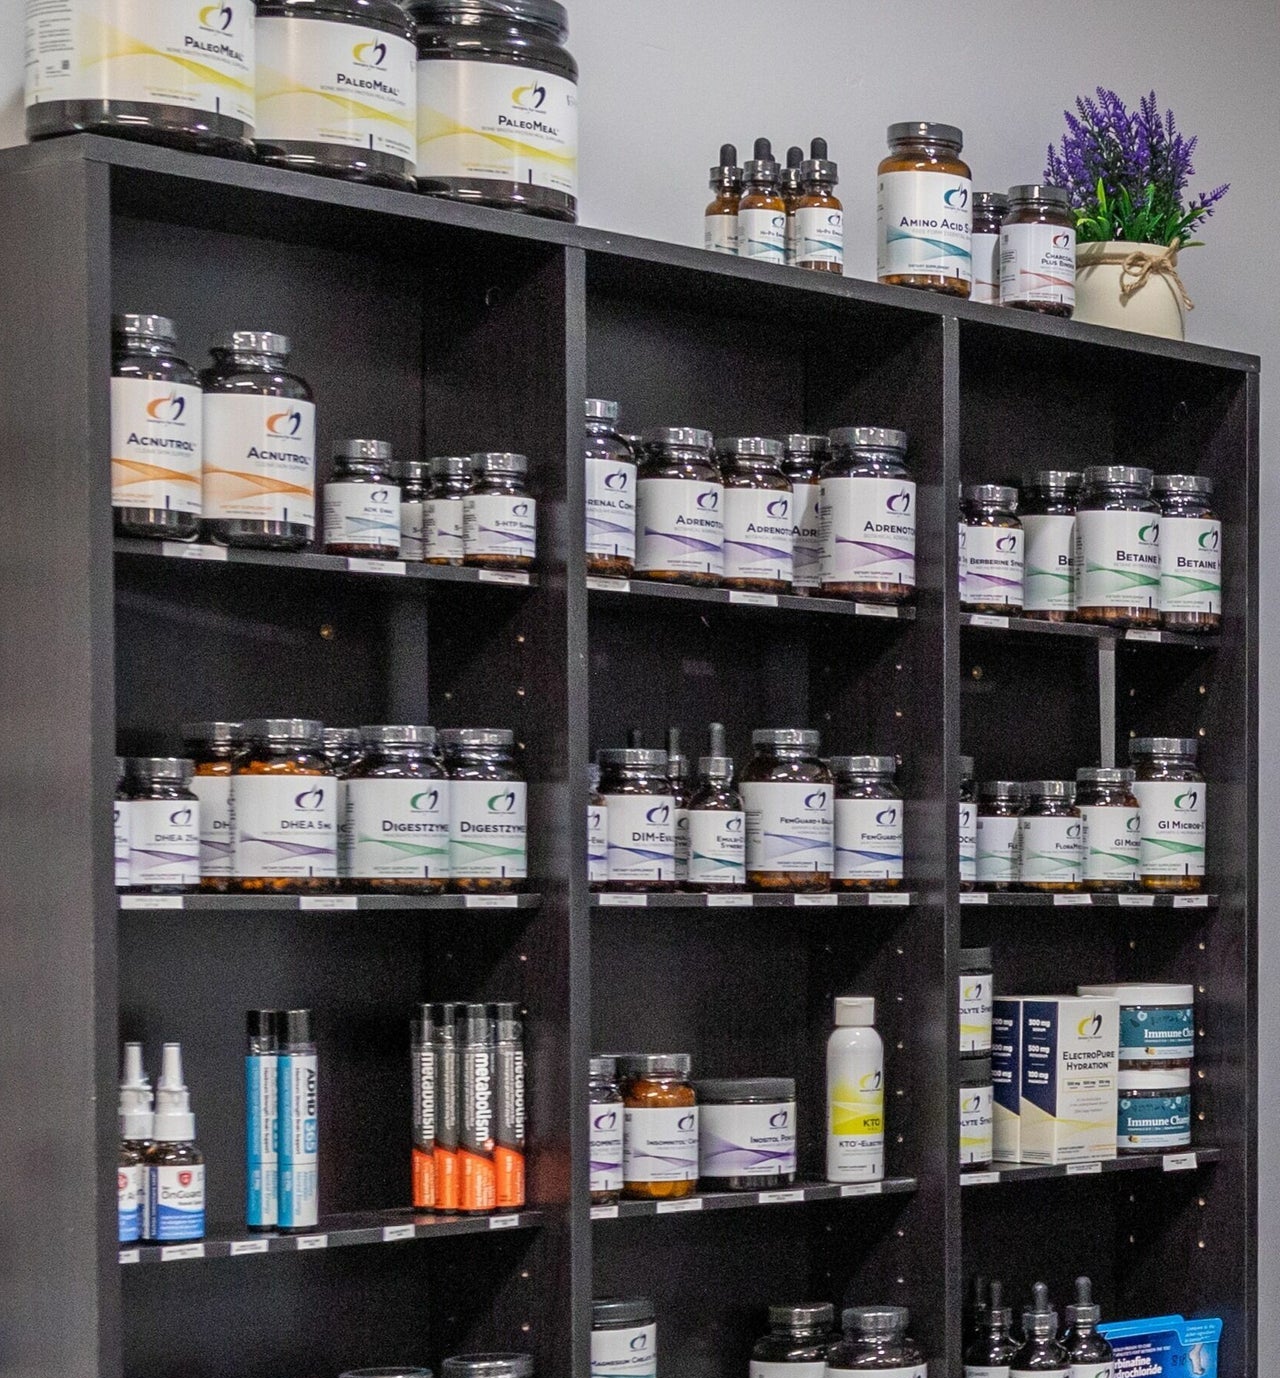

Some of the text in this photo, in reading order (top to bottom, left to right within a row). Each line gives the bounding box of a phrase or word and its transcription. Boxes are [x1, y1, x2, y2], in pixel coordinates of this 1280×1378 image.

[1158, 821, 1169, 829] GI
[1143, 1029, 1181, 1038] Immune
[474, 1052, 490, 1142] metabolism
[1127, 1117, 1169, 1127] Immune
